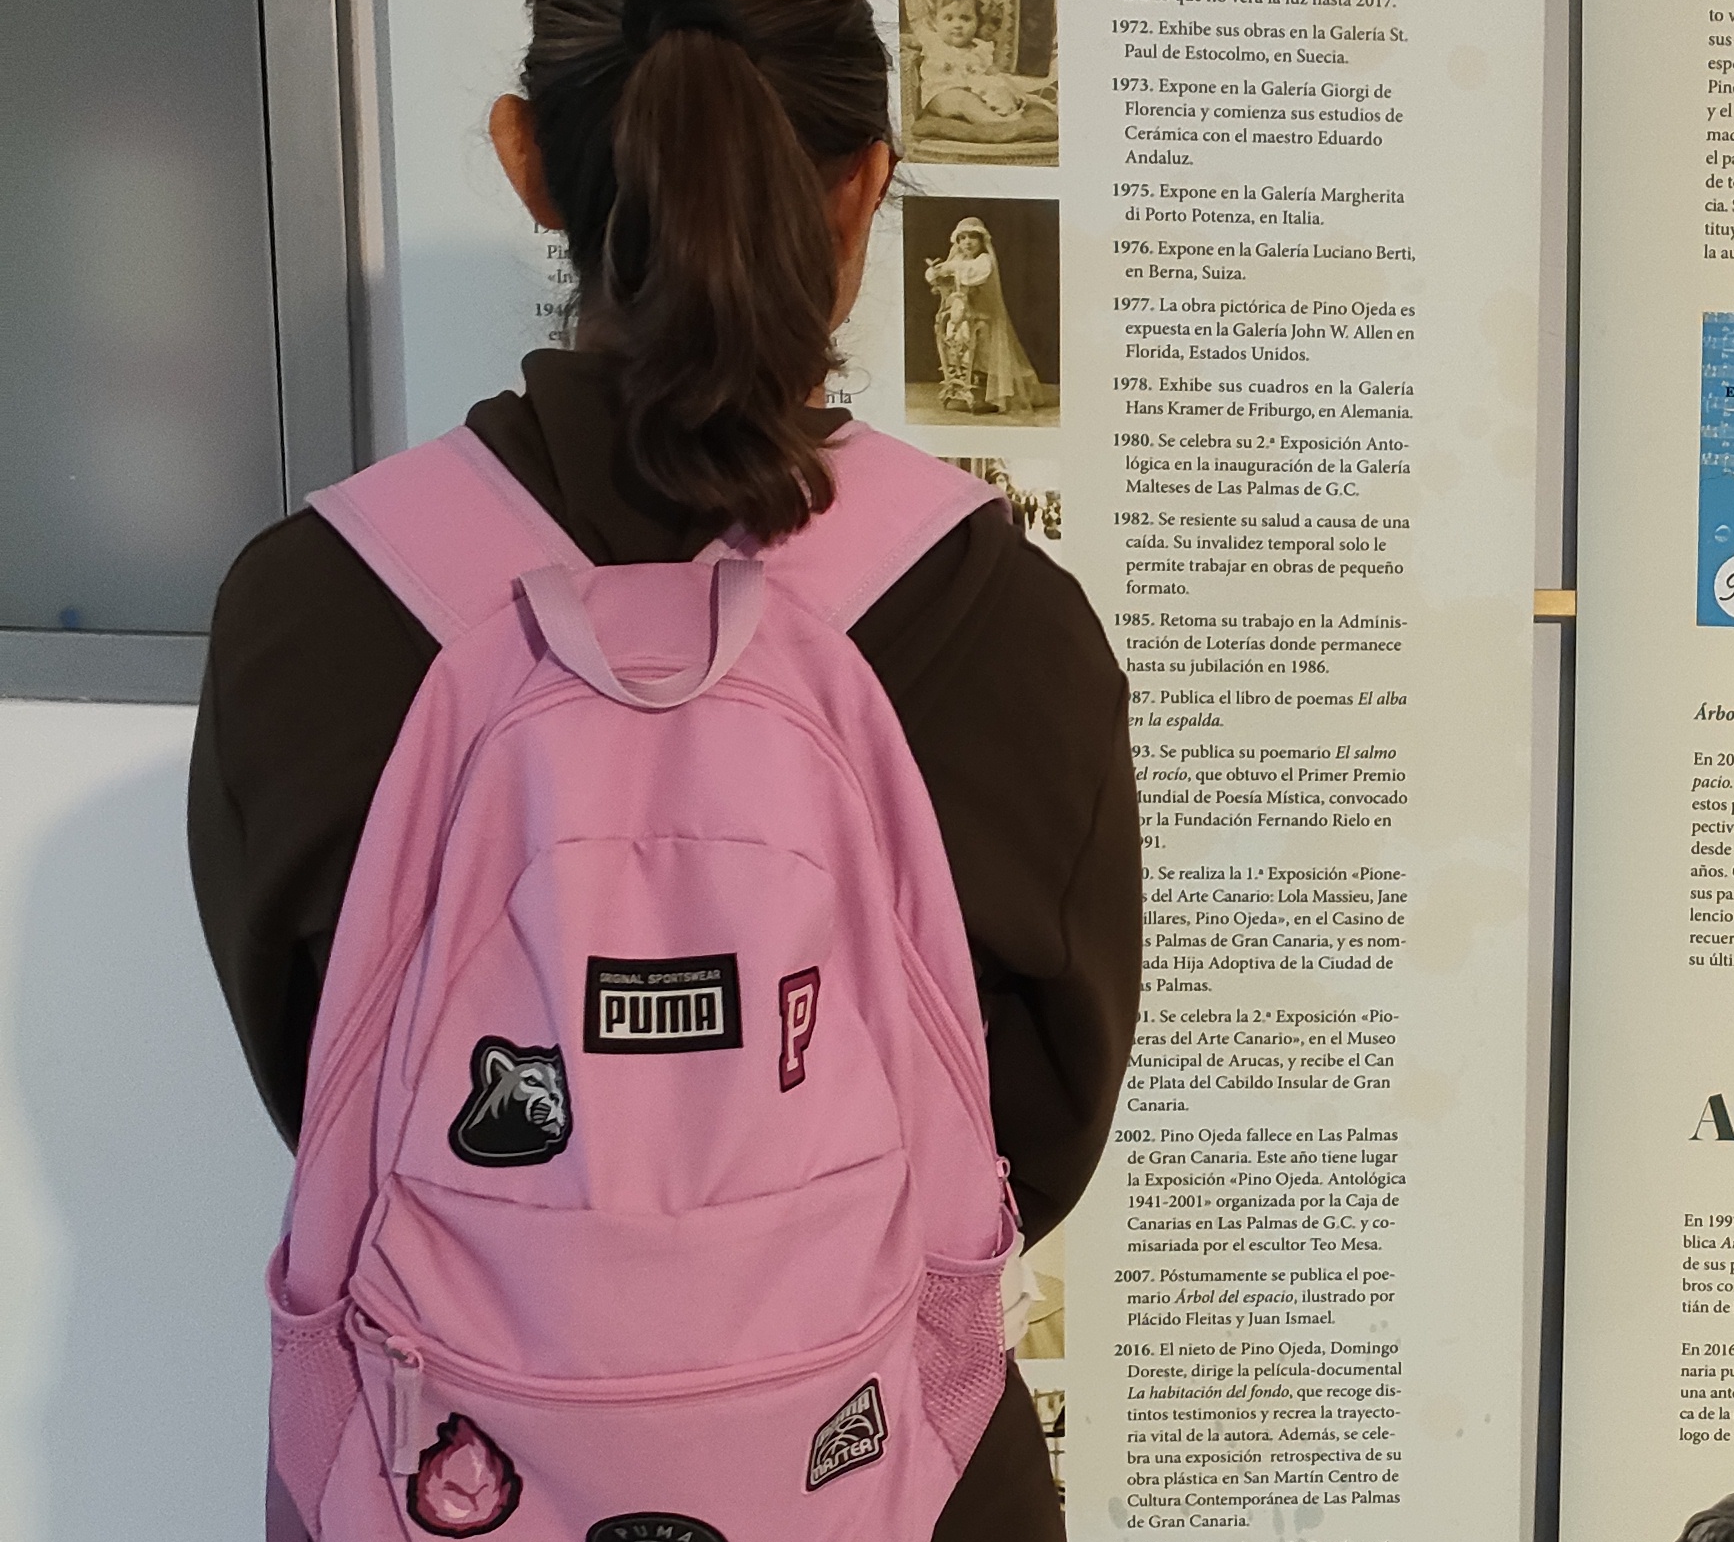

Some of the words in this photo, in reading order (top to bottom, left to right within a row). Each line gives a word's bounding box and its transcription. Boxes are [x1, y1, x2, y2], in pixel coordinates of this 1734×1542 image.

[600, 972, 644, 985] ORIGINAL
[648, 970, 721, 985] SPORTSWEAR
[606, 993, 716, 1034] PUMA
[786, 984, 813, 1072] P
[1683, 1213, 1704, 1228] En
[1678, 1427, 1710, 1446] logo
[1713, 1427, 1731, 1442] de
[812, 1439, 873, 1479] MASTER
